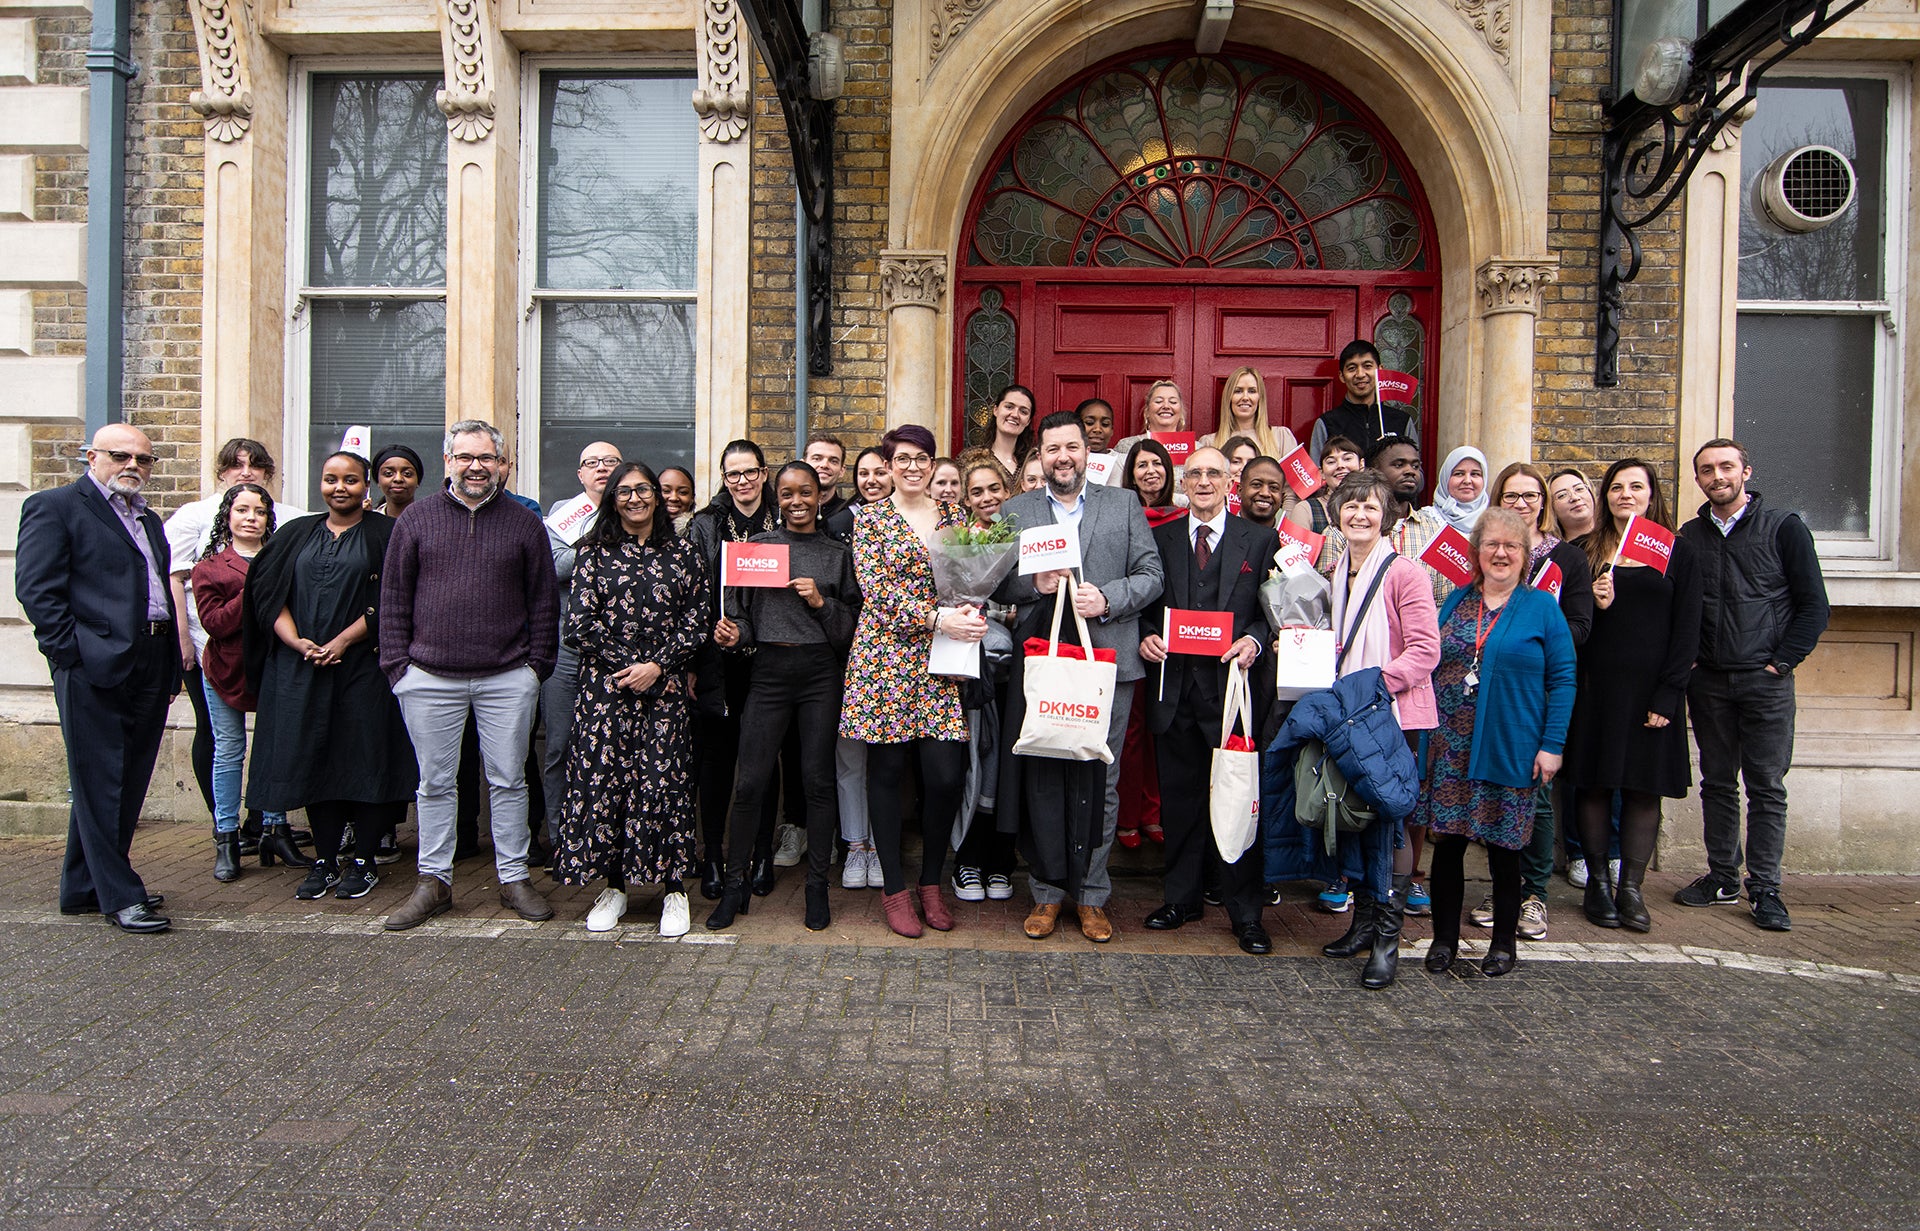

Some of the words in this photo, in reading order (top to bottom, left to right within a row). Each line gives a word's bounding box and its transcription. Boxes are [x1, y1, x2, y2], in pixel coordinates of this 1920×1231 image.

[1378, 380, 1400, 389] DKMS
[1163, 443, 1180, 451] KMS
[1292, 459, 1310, 482] DKMS
[558, 508, 587, 531] DKMS
[1022, 540, 1055, 555] DKMS
[1634, 532, 1665, 551] DKMS
[1438, 541, 1467, 565] DKMS
[736, 557, 768, 568] DKMS
[1178, 625, 1211, 637] DKMS
[1039, 701, 1085, 718] DKMS
